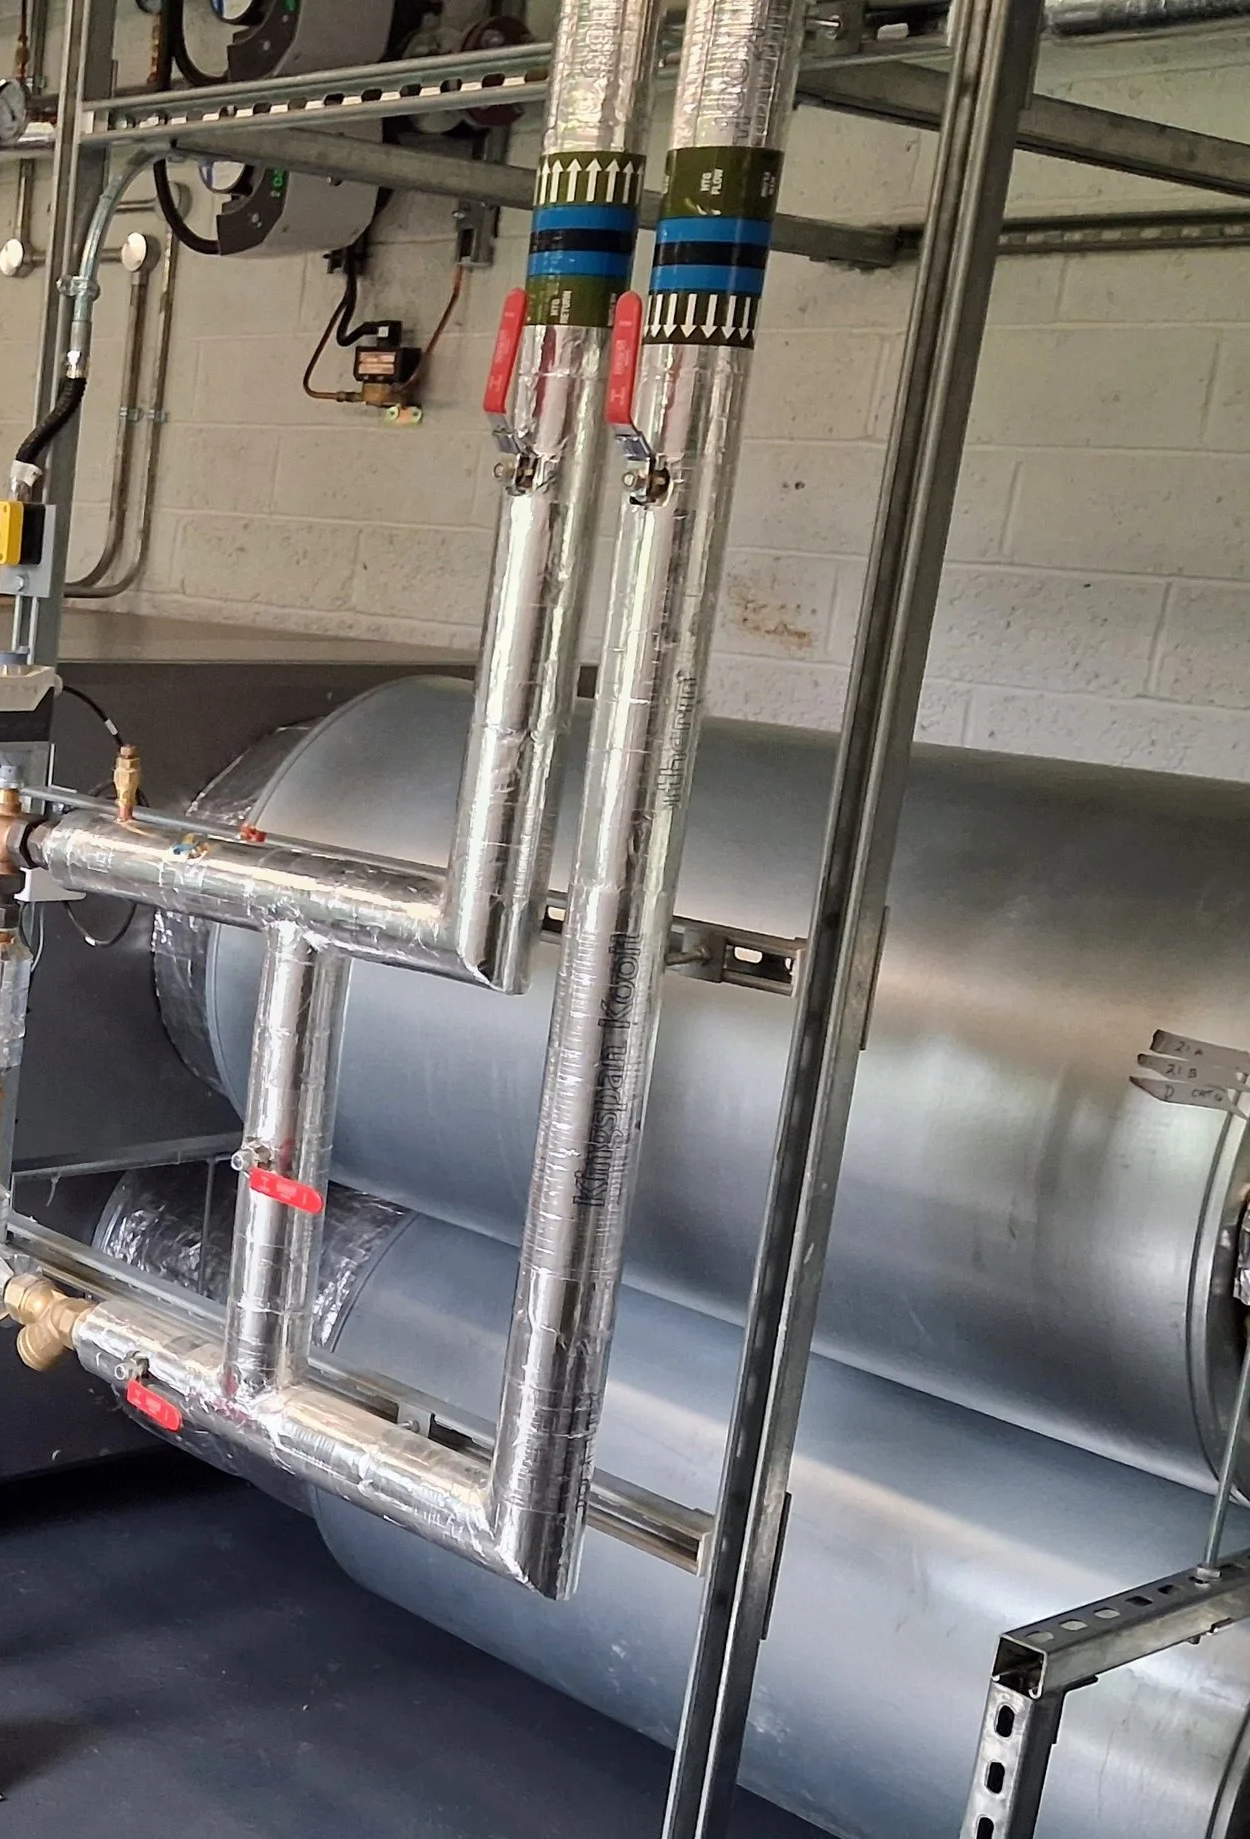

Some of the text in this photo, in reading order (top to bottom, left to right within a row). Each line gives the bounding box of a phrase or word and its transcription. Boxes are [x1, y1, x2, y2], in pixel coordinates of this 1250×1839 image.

[700, 172, 712, 192] HTG
[711, 168, 724, 195] FLOW
[559, 290, 572, 324] RETURN
[573, 1045, 627, 1207] Kingspan
